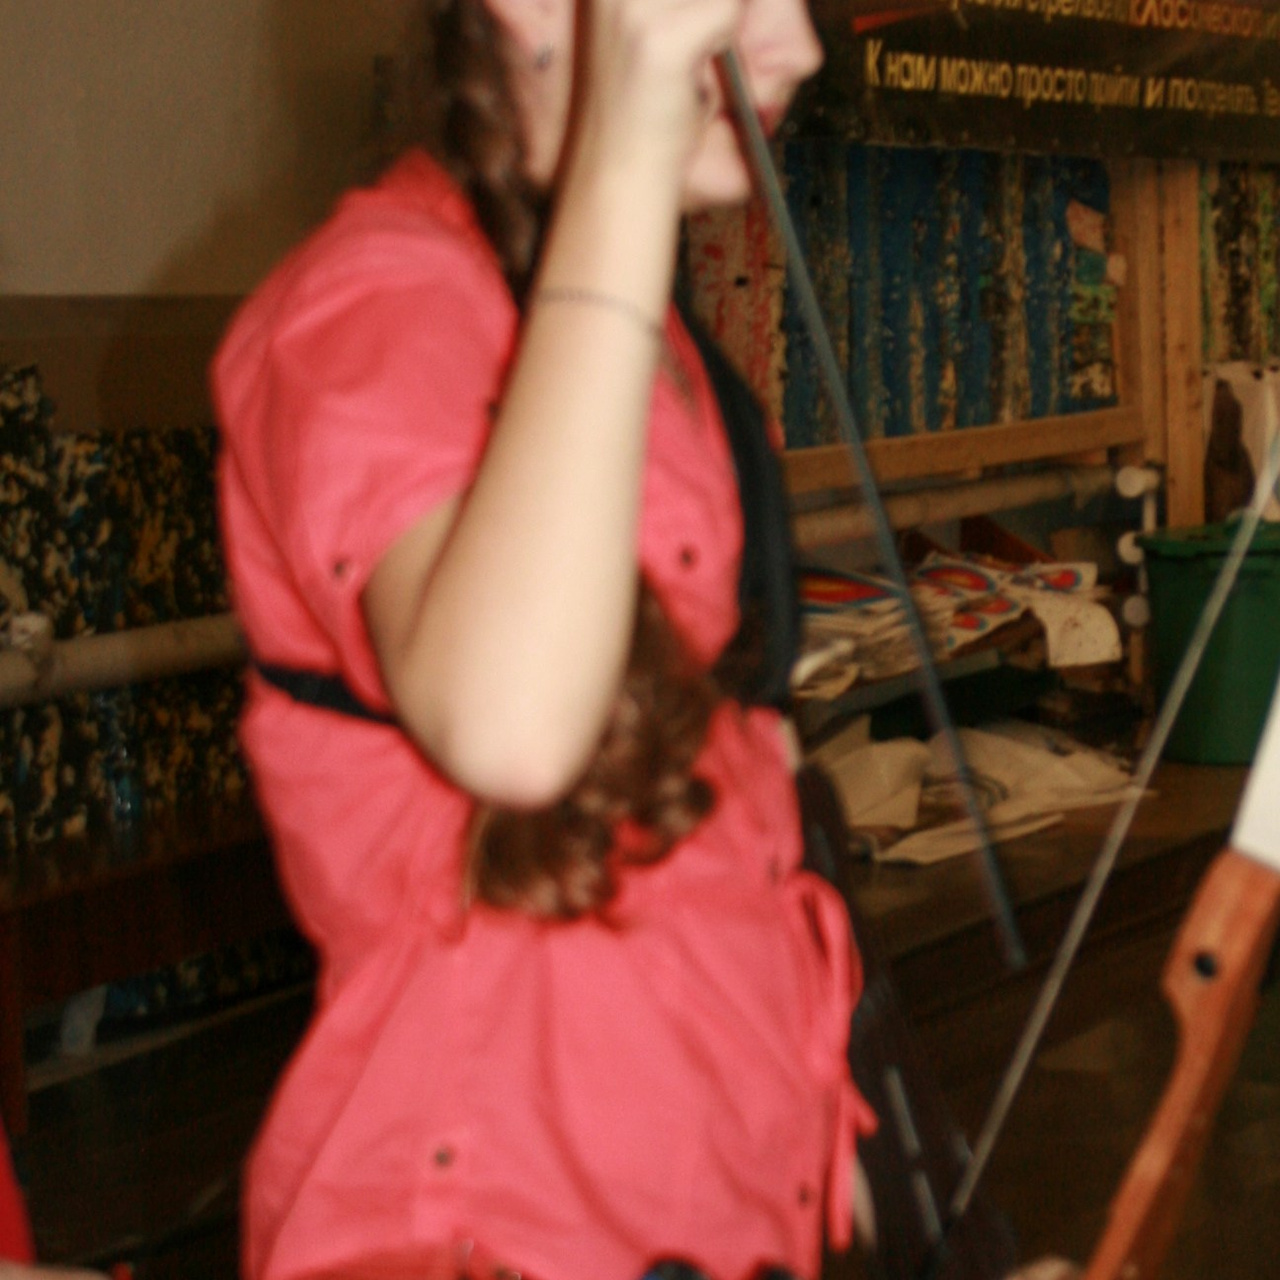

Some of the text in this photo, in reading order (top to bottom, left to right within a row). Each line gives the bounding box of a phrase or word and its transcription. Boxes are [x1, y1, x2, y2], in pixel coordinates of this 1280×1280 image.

[864, 39, 883, 88] К
[884, 51, 938, 92] нам
[939, 55, 1014, 99] можно
[1015, 63, 1088, 110] просто
[1143, 76, 1166, 110] и
